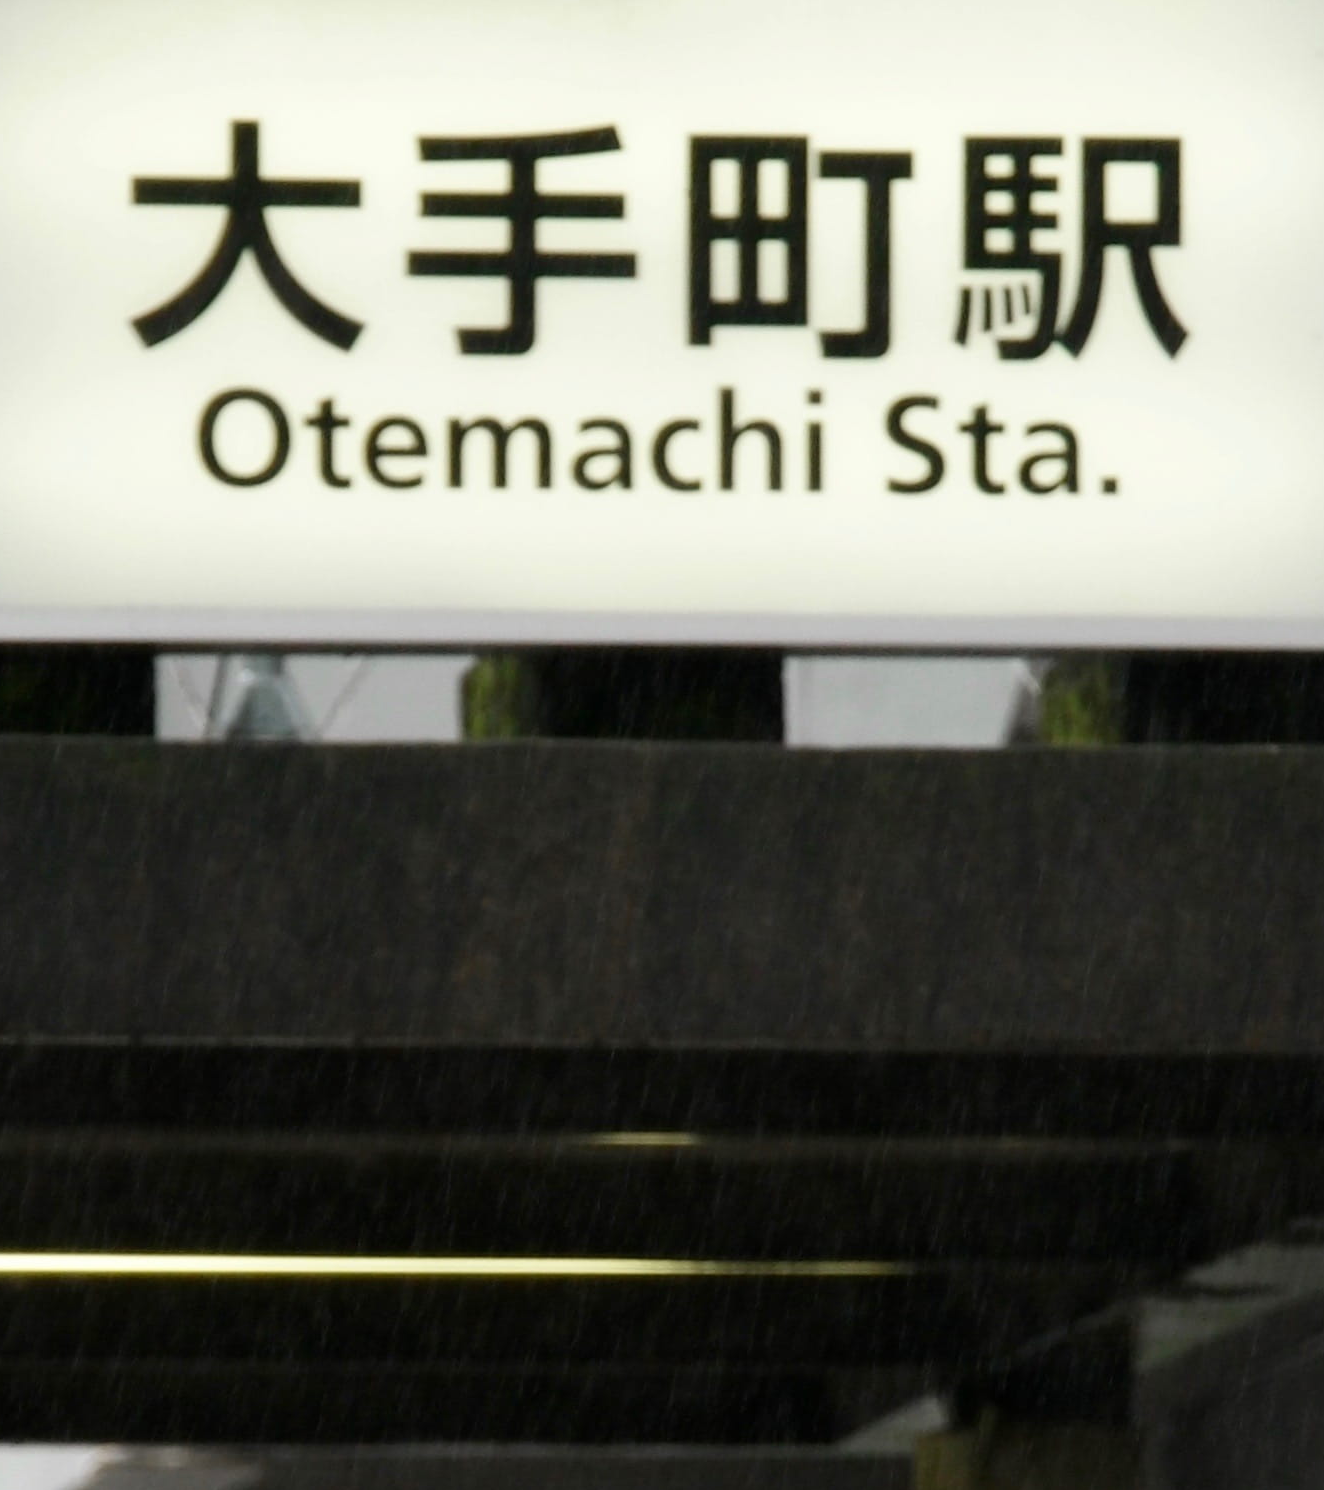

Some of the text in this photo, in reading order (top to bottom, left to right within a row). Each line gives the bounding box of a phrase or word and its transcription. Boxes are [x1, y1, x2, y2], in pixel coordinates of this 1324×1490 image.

[130, 119, 1190, 362] 大手町駅
[197, 387, 1121, 497] Otemachi Sta.
